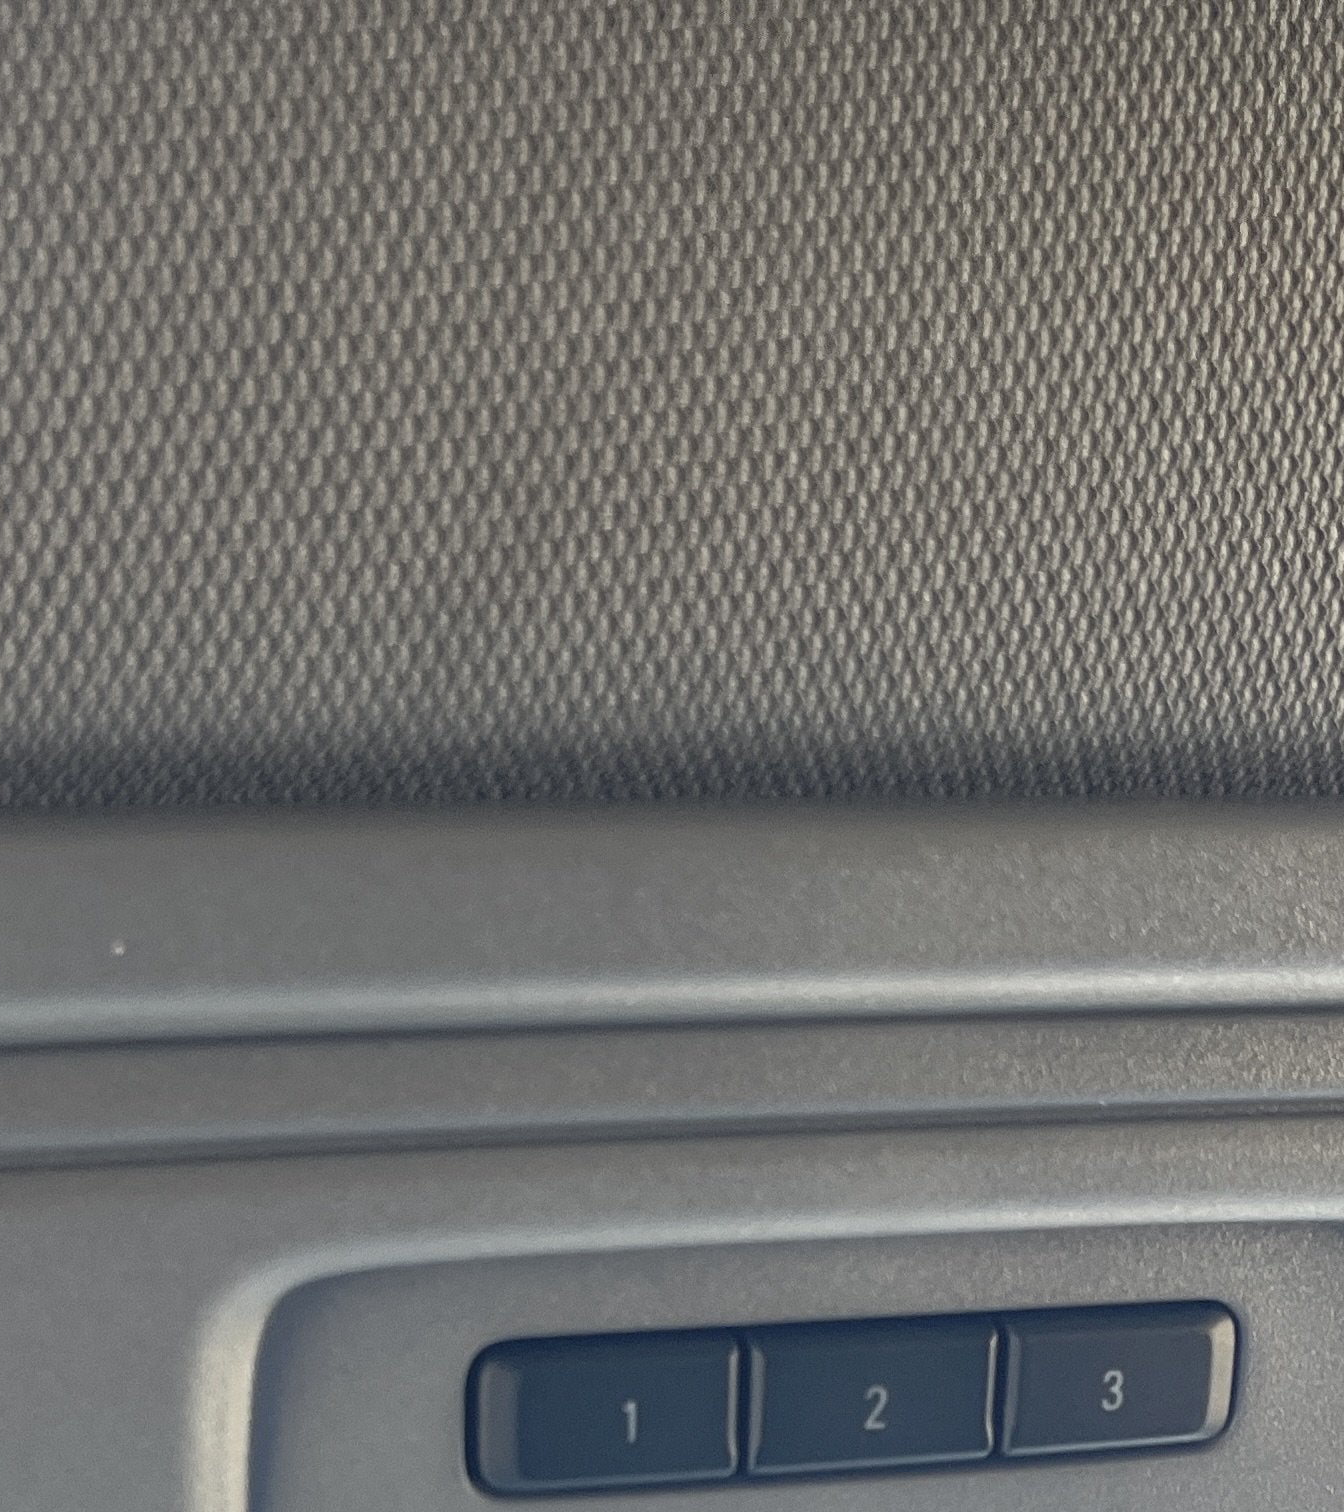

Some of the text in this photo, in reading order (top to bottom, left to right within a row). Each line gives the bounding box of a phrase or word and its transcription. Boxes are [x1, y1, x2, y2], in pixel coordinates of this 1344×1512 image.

[863, 1385, 890, 1430] 2
[1100, 1369, 1125, 1411] 3
[621, 1399, 638, 1443] 1
